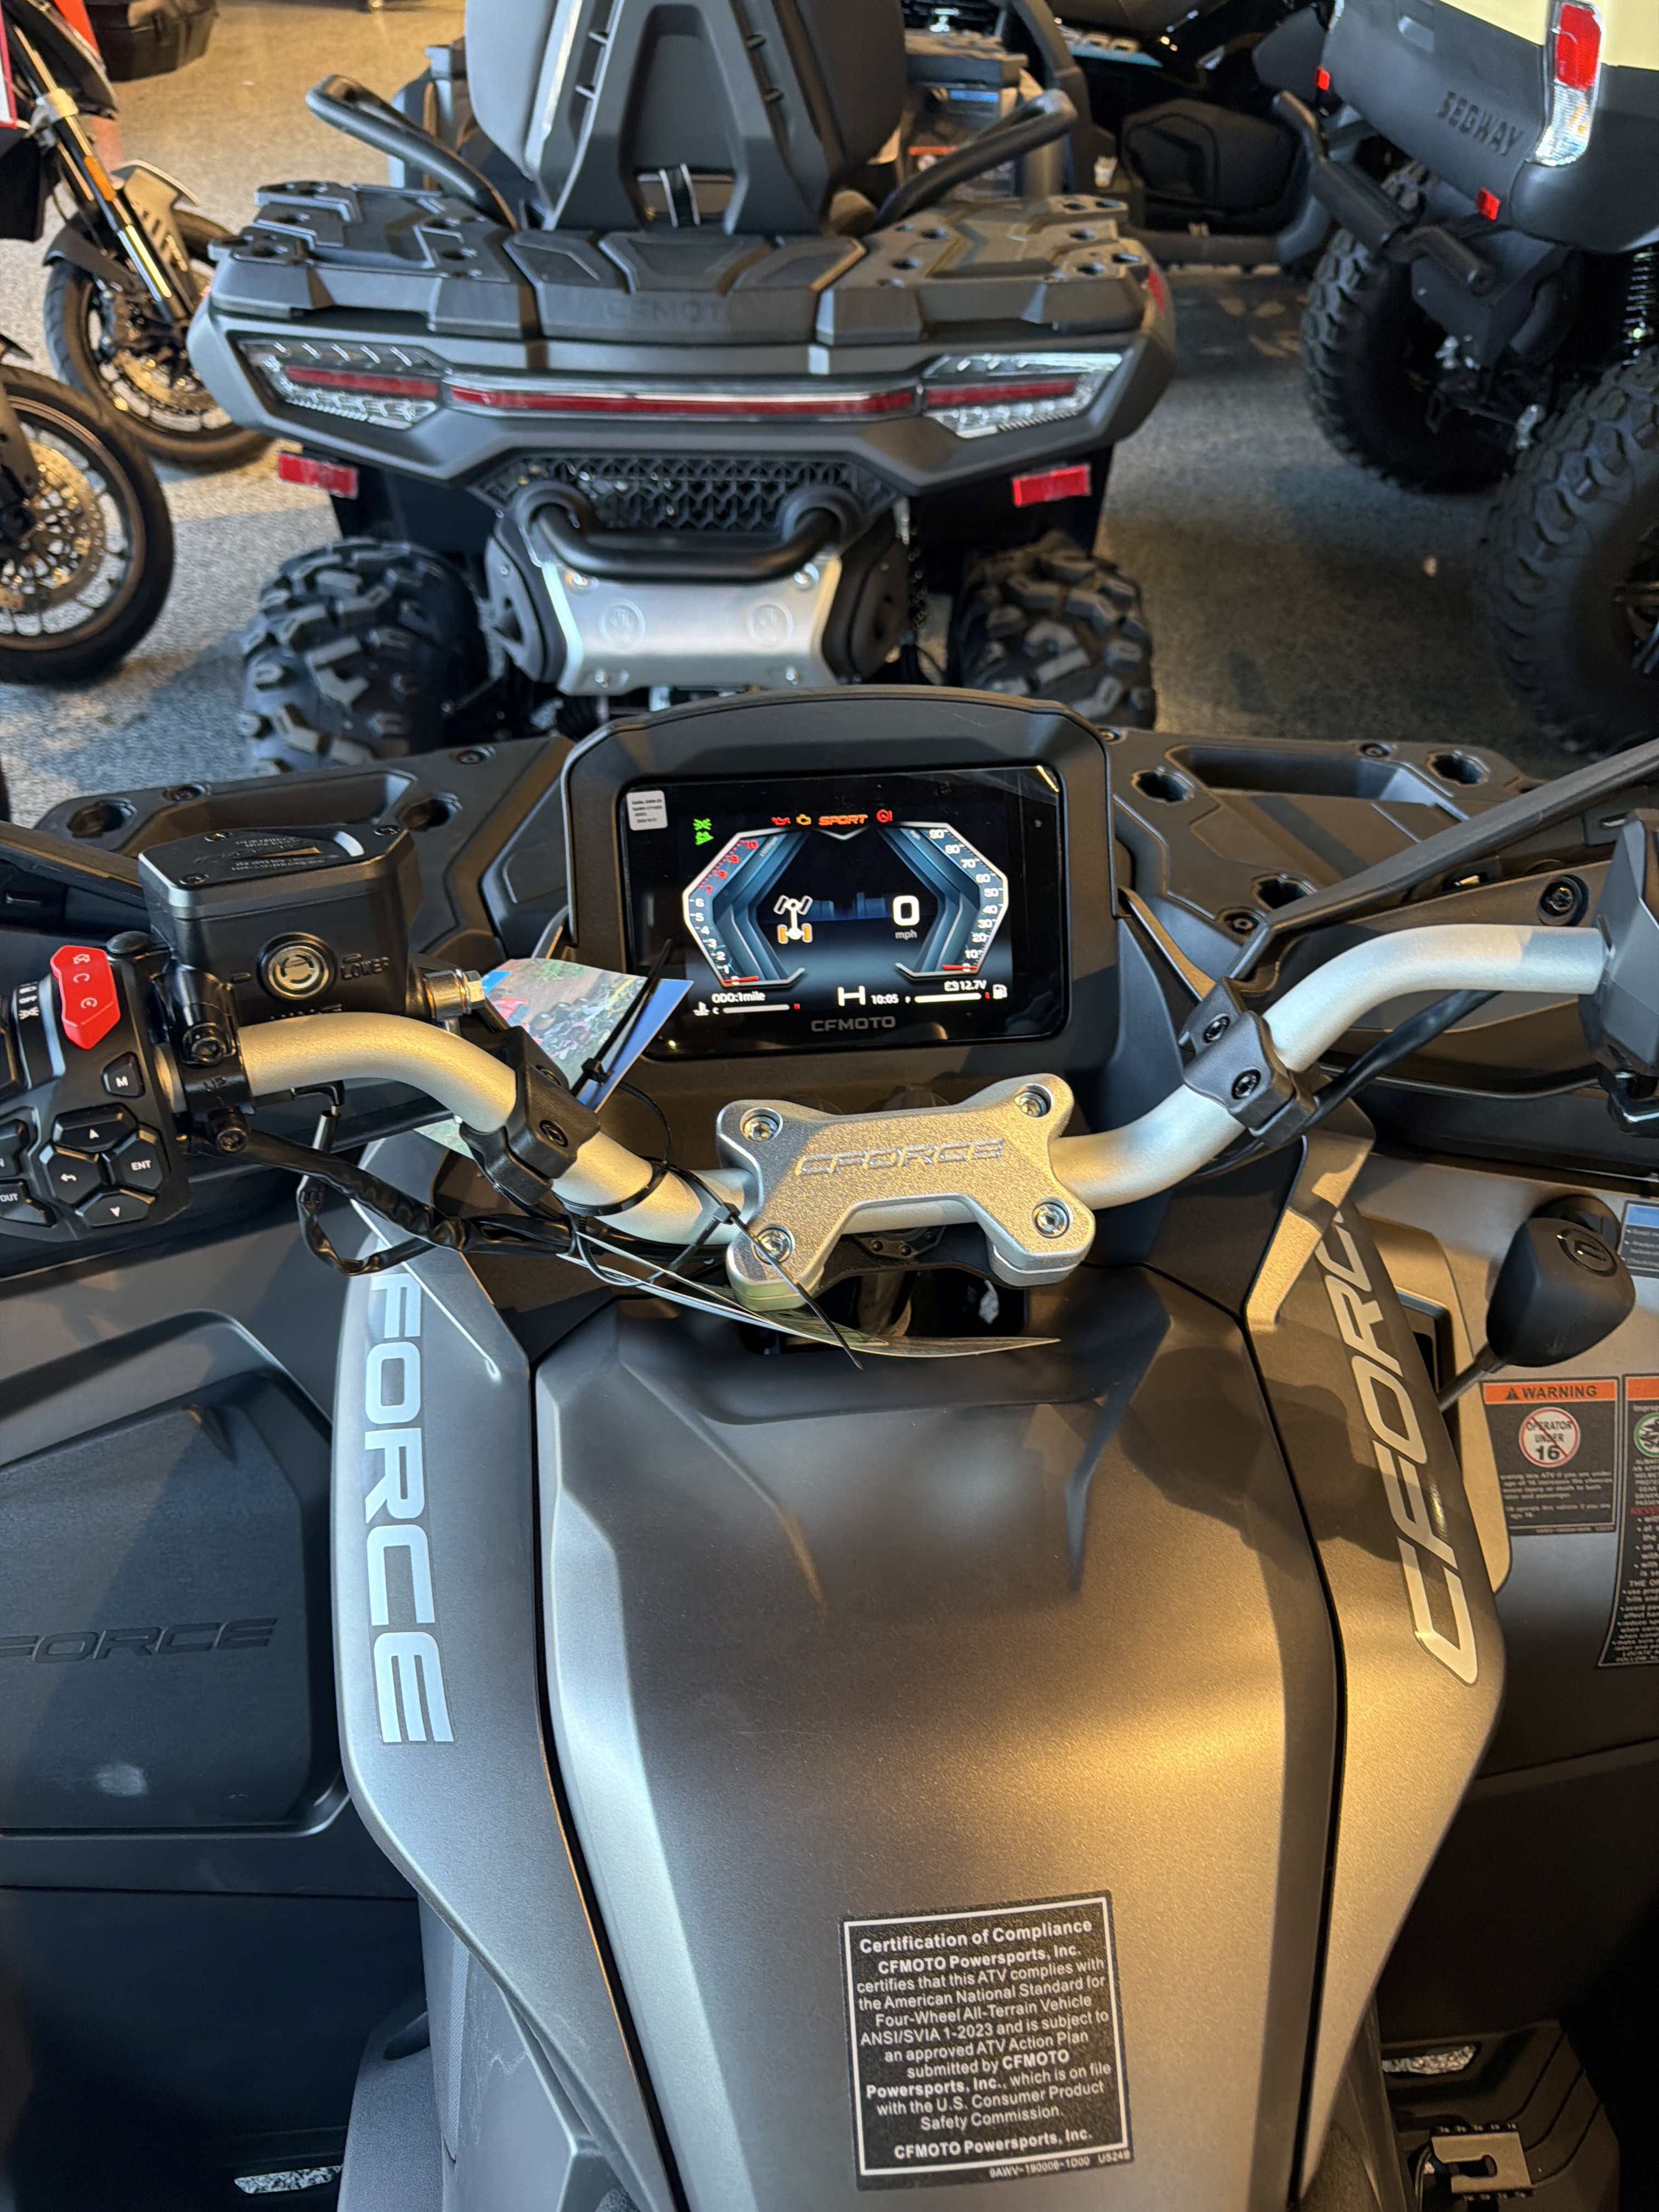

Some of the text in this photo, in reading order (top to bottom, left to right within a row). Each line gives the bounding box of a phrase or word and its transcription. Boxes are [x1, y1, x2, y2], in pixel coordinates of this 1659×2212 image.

[1436, 91, 1525, 157] SEGWAY
[819, 815, 868, 826] SPORT
[929, 829, 944, 839] 90
[744, 840, 759, 850] 10
[945, 844, 960, 854] 80
[730, 854, 739, 864] 9
[961, 859, 976, 868] 70
[718, 870, 727, 879] 8
[975, 873, 991, 883] 60
[704, 885, 713, 895] 7
[984, 888, 999, 898] 50
[695, 898, 704, 907] 6
[892, 895, 920, 927] 0
[983, 905, 997, 915] 40
[695, 912, 704, 922] 5
[978, 919, 992, 929] 30
[700, 926, 710, 935] 4
[895, 929, 918, 941] mph
[708, 938, 717, 948] 3
[972, 933, 987, 943] 20
[716, 951, 726, 961] 2
[964, 949, 978, 959] 10
[723, 964, 730, 974] 1
[960, 980, 987, 991] 12.7V
[837, 985, 866, 1007] H
[871, 994, 899, 1005] 10:05
[811, 1015, 896, 1032] CFMOTO
[116, 1076, 129, 1088] M
[794, 1138, 1005, 1177] CFORCE
[131, 1159, 151, 1170] ENT
[0, 1193, 19, 1202] OUT
[1522, 1385, 1597, 1399] WARNING
[1314, 1210, 1477, 1684] CFORC
[1536, 1445, 1561, 1460] 16
[365, 1273, 455, 1743] FORCE
[860, 1920, 1092, 1954] Certification of Compliance
[878, 1956, 946, 1974] CFMOTO
[1053, 1945, 1081, 1958] Inc.
[857, 1957, 1104, 1993] certifies that this ATV complies with
[859, 1975, 1105, 2011] the American National Standard for
[876, 1994, 1092, 2027] Four-Wheel All-Terrain Vehicle
[861, 2010, 1109, 2046] ANSI/SVIA 1-2023 and is subject to
[884, 2030, 1089, 2063] an approved ATV Action Plan
[907, 2049, 1070, 2079] submitted by CFMOTO
[1009, 2069, 1051, 2086] which
[1054, 2067, 1066, 2081] is
[1069, 2066, 1087, 2079] on
[1089, 2061, 1111, 2076] file
[876, 2080, 1104, 2115] with the U.S. Consumer Product
[921, 2105, 1064, 2131] Safety Commission.
[894, 2141, 961, 2159] CFMOTO
[1065, 2128, 1093, 2142] Inc.
